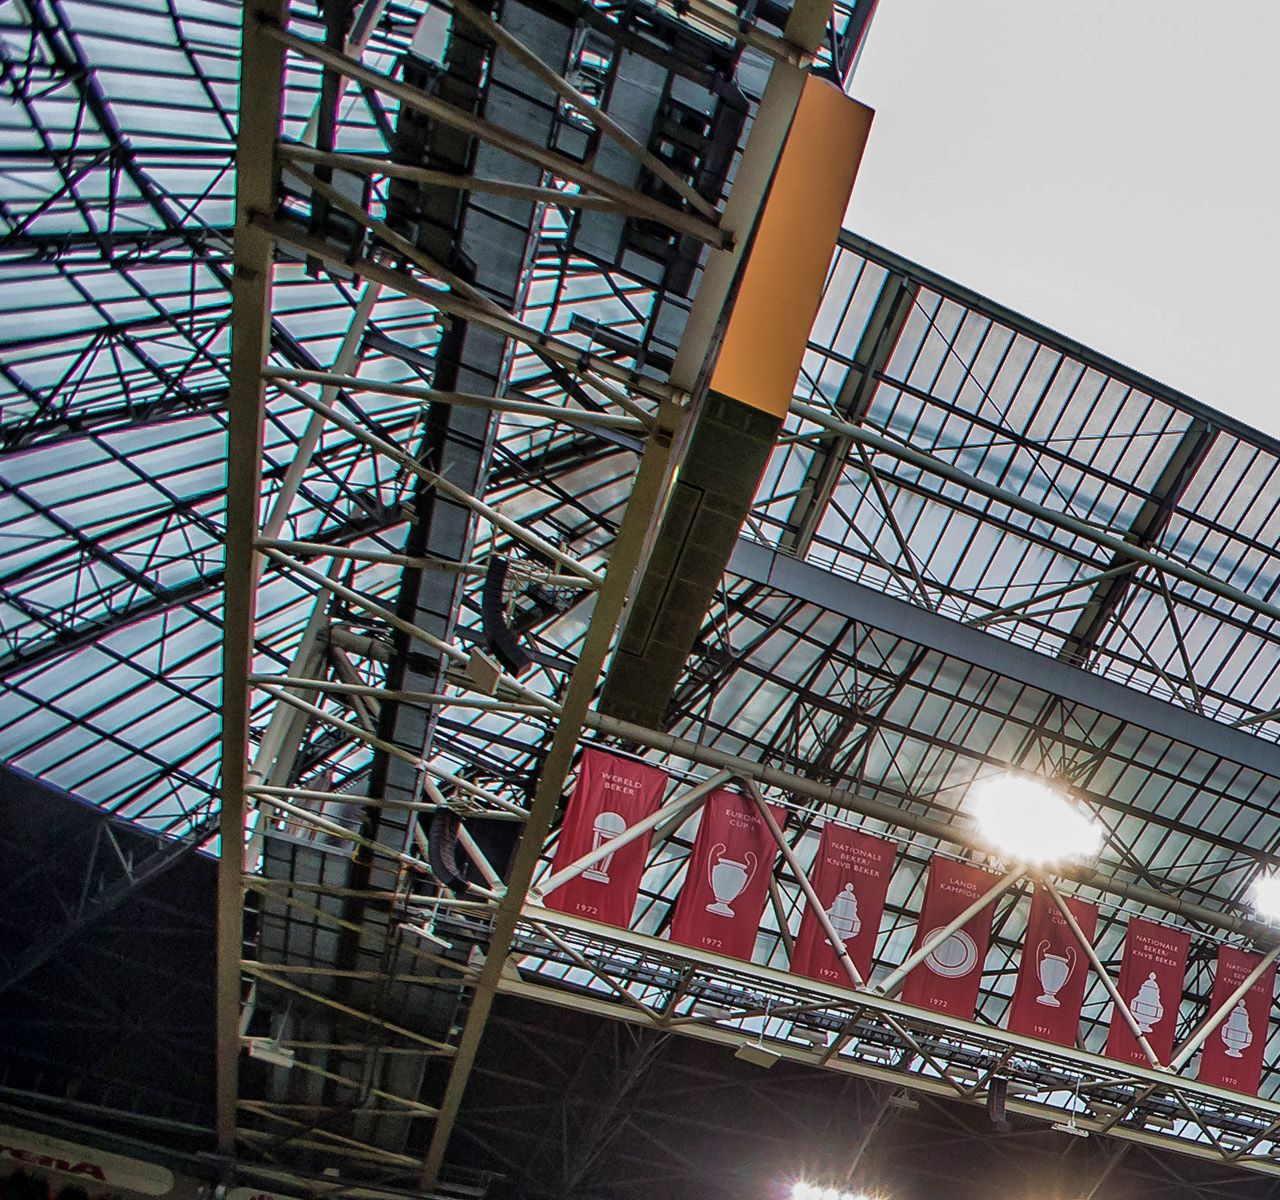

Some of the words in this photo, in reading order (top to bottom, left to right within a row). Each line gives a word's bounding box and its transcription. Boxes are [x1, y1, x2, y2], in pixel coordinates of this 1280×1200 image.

[601, 771, 642, 790] WERELD
[604, 782, 635, 796] BEKER
[831, 841, 883, 863] NATIONALE
[826, 857, 851, 870] KNVB
[853, 864, 880, 878] BEKER
[949, 877, 977, 891] LANDS
[576, 903, 599, 915] 1972
[701, 936, 723, 948] 1972
[1136, 934, 1179, 953] NATIONALE
[1133, 948, 1154, 961] KNVB
[1155, 955, 1178, 968] BEKER
[819, 967, 839, 980] 1972
[929, 996, 949, 1008] 1972
[1034, 1025, 1051, 1035] 1971
